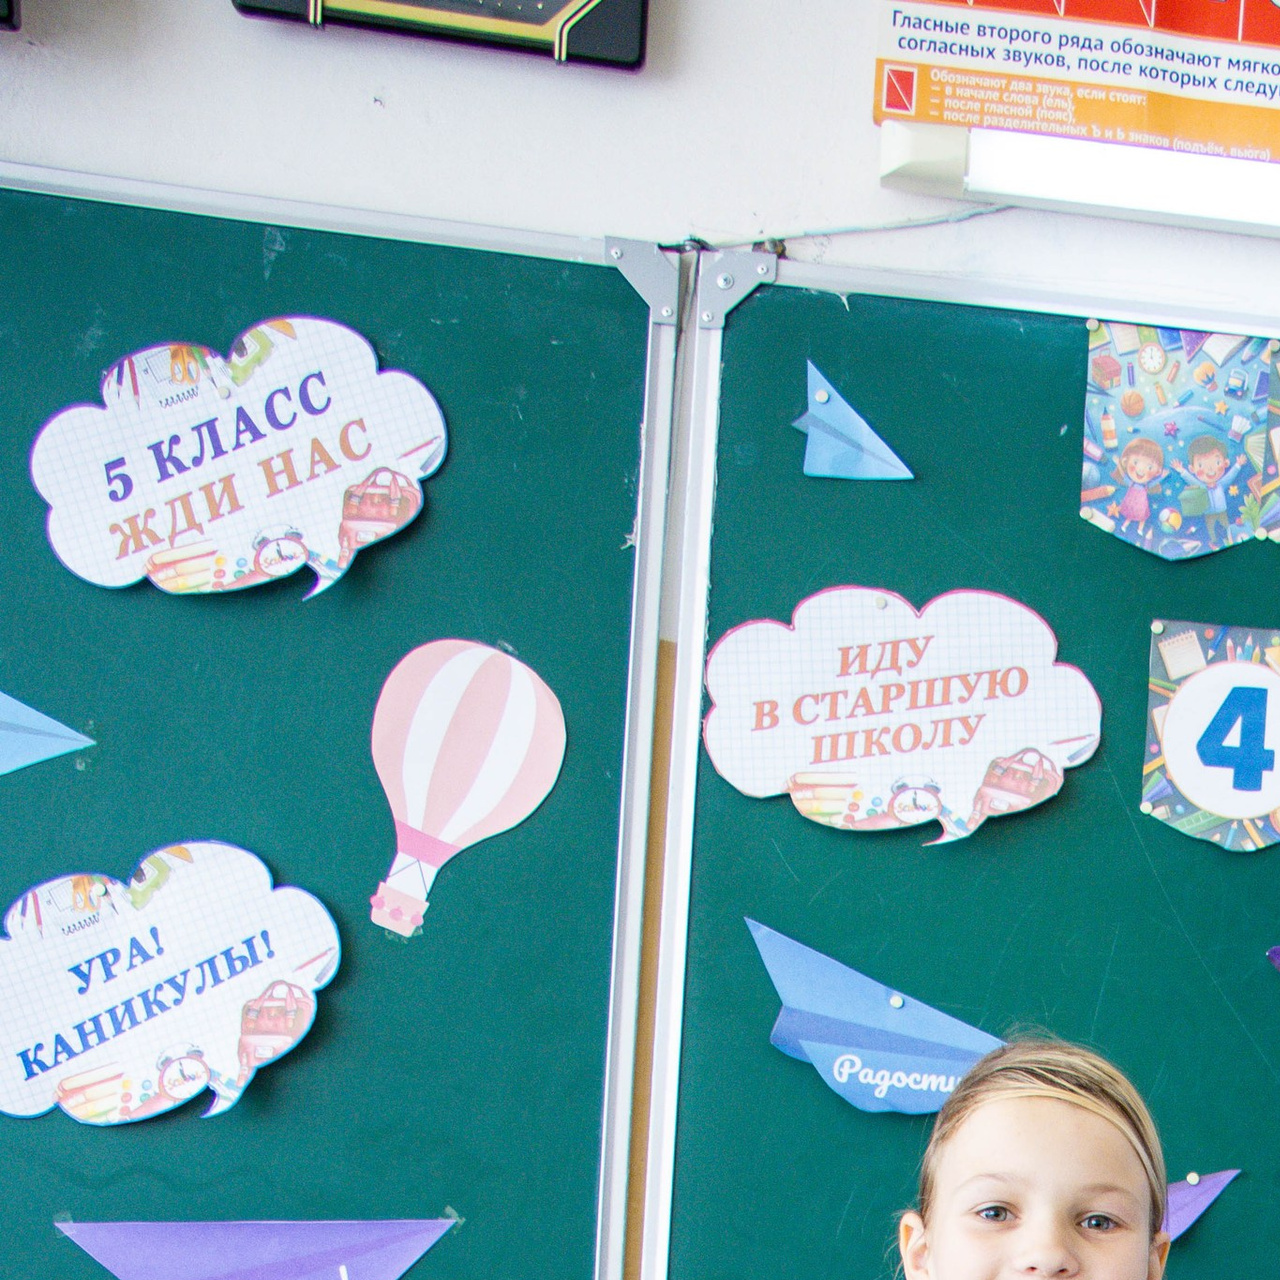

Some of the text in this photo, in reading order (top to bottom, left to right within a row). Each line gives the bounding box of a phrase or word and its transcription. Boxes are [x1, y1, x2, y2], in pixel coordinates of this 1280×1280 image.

[891, 10, 970, 35] Гласные
[976, 23, 1052, 45] второго
[1058, 30, 1104, 52] ряда
[1110, 37, 1222, 69] обозначают
[897, 36, 995, 60] согласных
[1002, 48, 1071, 71] звуков,
[1077, 55, 1133, 75] после
[1139, 64, 1217, 89] которых
[930, 68, 1007, 89] Обозначают
[1010, 80, 1033, 92] два
[1077, 88, 1105, 101] если
[945, 98, 981, 110] после
[984, 102, 1033, 117] гласной
[955, 86, 999, 100] начале
[1003, 92, 1039, 106] слова
[944, 110, 980, 124] после
[984, 115, 1087, 137] разделительных
[1129, 132, 1170, 148] знаков
[103, 370, 333, 503] 5 КЛАСС
[109, 418, 373, 560] ЖДИ НАС
[835, 635, 934, 680] ИДУ
[751, 666, 1029, 731] В СТАРШУЮ
[808, 714, 987, 765] ШКОЛУ
[1195, 686, 1276, 794] 4
[67, 925, 166, 996] УРА!
[15, 929, 277, 1081] КАНИКУЛЫ!
